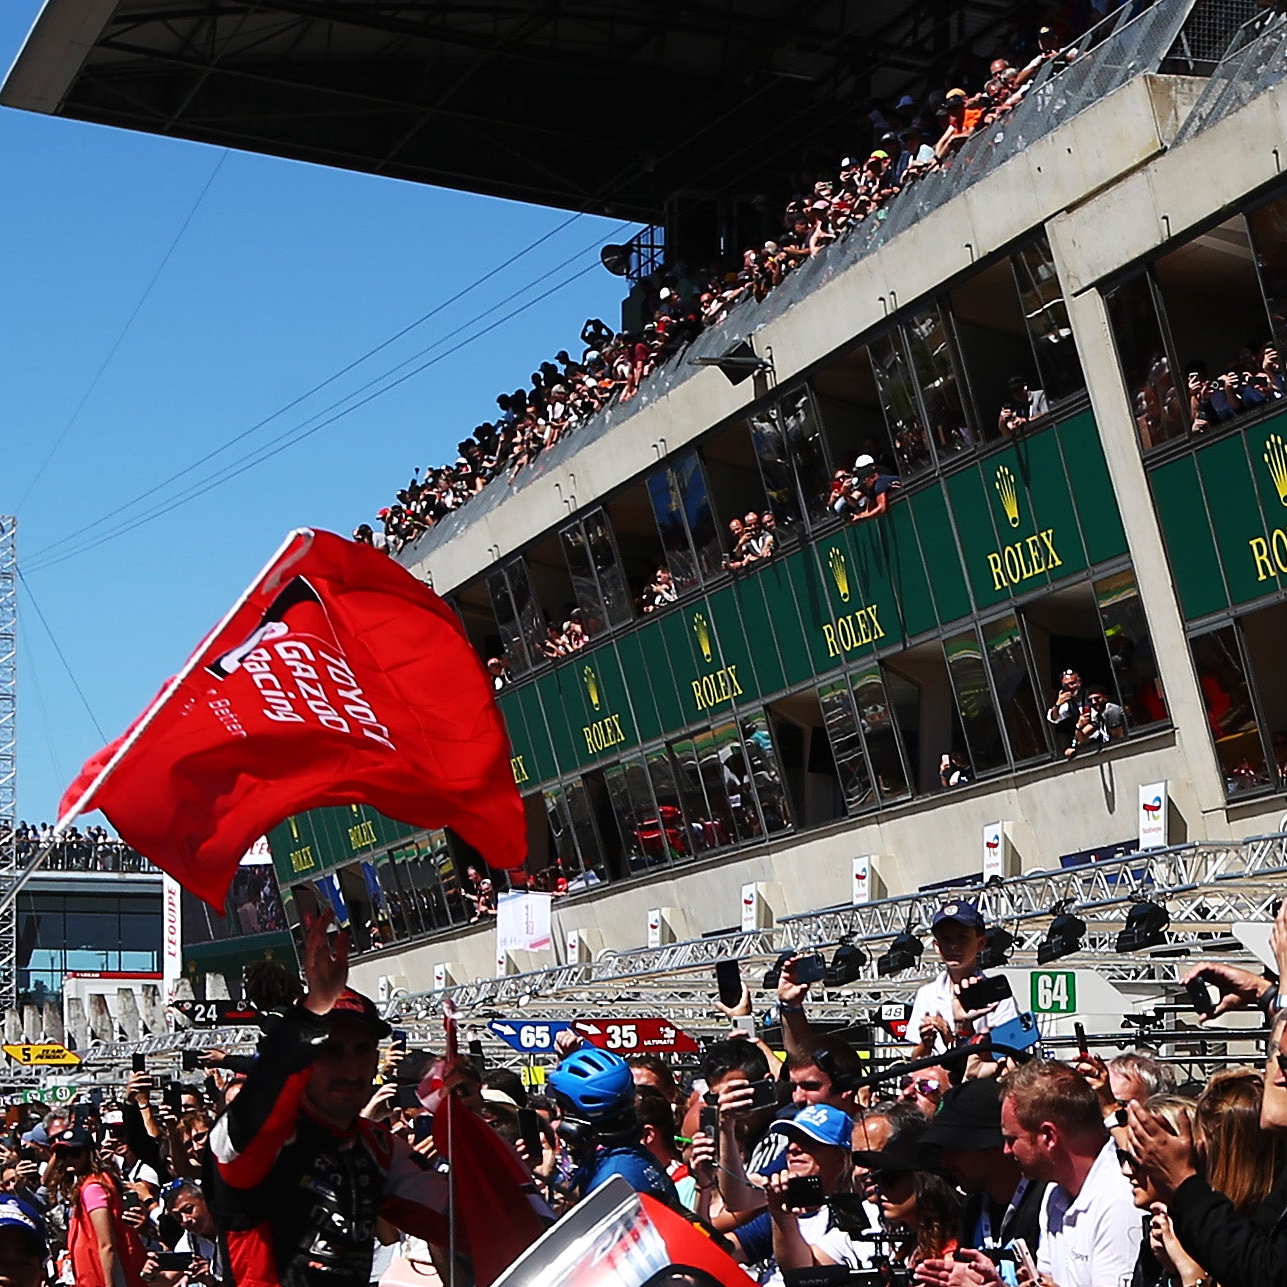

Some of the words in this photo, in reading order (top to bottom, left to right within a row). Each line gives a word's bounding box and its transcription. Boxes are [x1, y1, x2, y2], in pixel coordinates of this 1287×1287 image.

[987, 530, 1063, 591] ROLEX
[822, 604, 886, 657] ROLEX
[242, 648, 306, 723] Racing
[273, 641, 351, 733] GAZOO
[691, 663, 743, 711] ROLEX
[583, 713, 627, 755] ROLEX
[1037, 972, 1069, 1010] 64
[194, 1003, 218, 1022] 24
[884, 1005, 903, 1018] 48
[22, 1047, 31, 1062] 5
[520, 1025, 551, 1048] 65
[606, 1025, 638, 1049] 35
